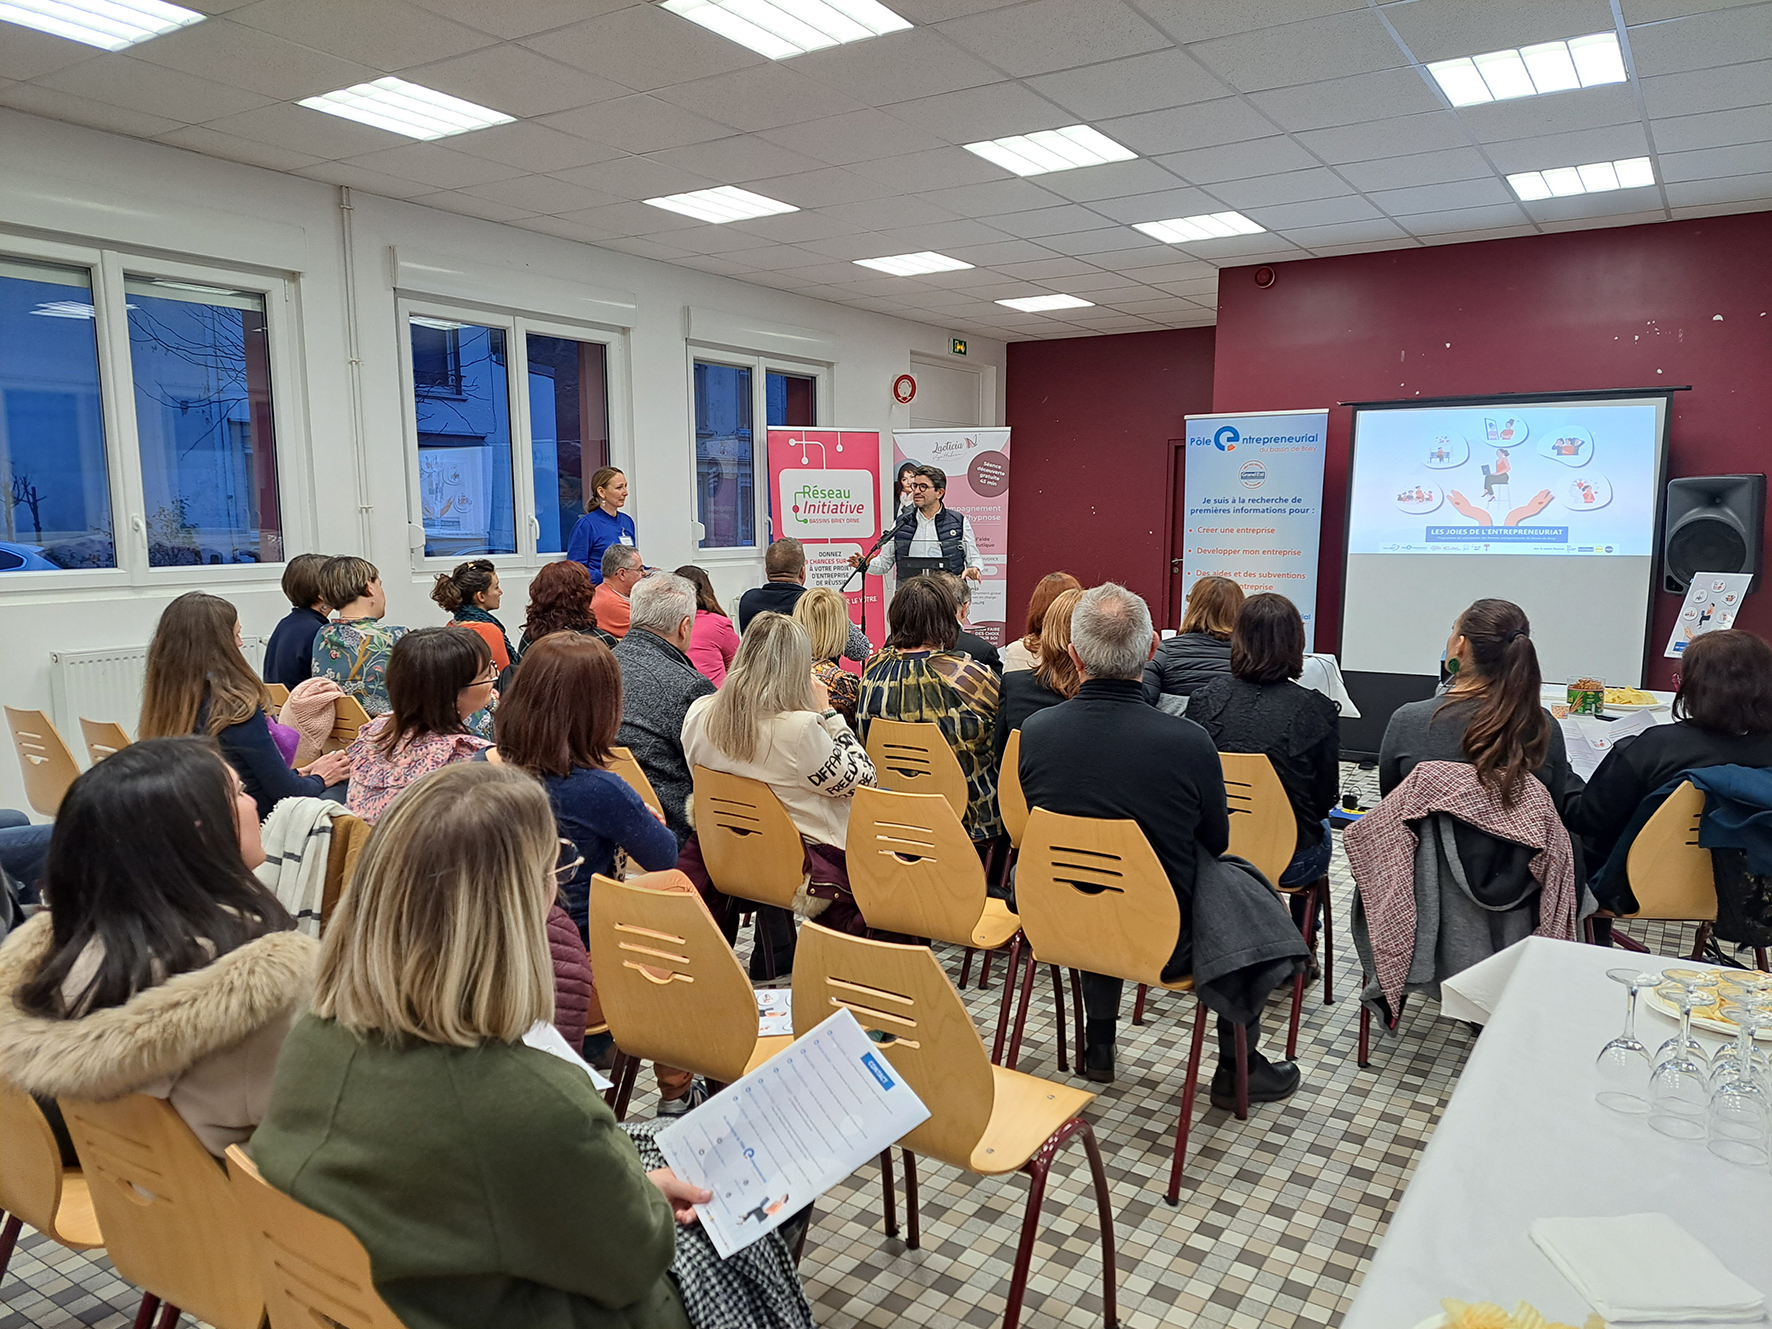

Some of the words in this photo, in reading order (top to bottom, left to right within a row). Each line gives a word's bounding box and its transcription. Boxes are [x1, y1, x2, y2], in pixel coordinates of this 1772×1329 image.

[1190, 436, 1212, 446] Pôle
[983, 461, 1002, 470] Séance
[977, 467, 1005, 476] découverte
[980, 473, 1000, 481] gratuite
[802, 485, 851, 499] Réseau
[1231, 496, 1236, 504] à
[1238, 496, 1245, 504] la
[803, 501, 865, 514] Initiative
[1190, 507, 1231, 515] premières
[1232, 506, 1287, 514] informations
[1197, 526, 1218, 534] Créer
[1236, 527, 1276, 535] entreprise
[1262, 548, 1302, 557] entreprise
[1258, 571, 1306, 579] subventions
[1239, 583, 1274, 591] ntreprise
